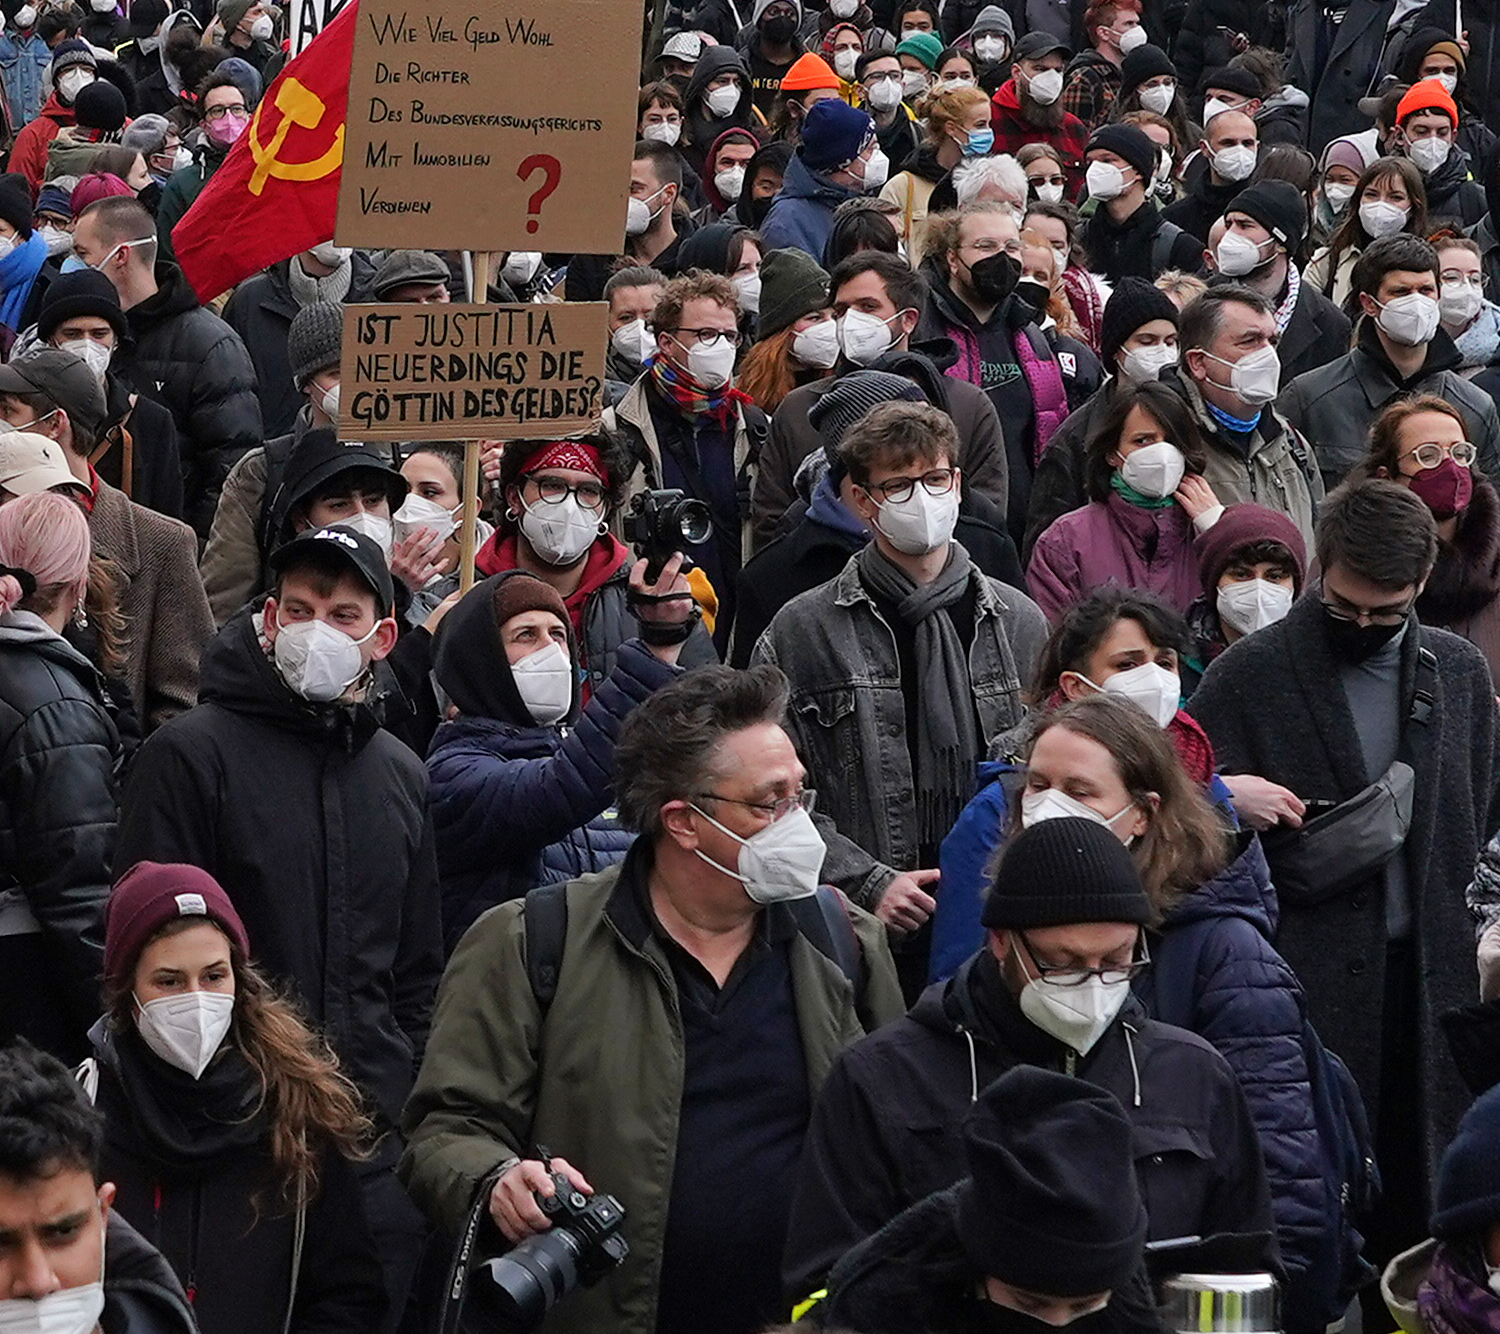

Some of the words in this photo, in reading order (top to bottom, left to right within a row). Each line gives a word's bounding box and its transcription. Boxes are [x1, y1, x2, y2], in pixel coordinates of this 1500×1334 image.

[515, 153, 561, 234] ?
[357, 313, 400, 347] IST
[413, 309, 557, 348] JUSTITIA
[356, 351, 528, 386] NEUERDINGS
[539, 349, 584, 381] DIE
[351, 383, 458, 429] GÖTTIN
[462, 387, 509, 420] DES
[509, 376, 601, 424] GELDES?
[451, 1264, 464, 1299] EOS
